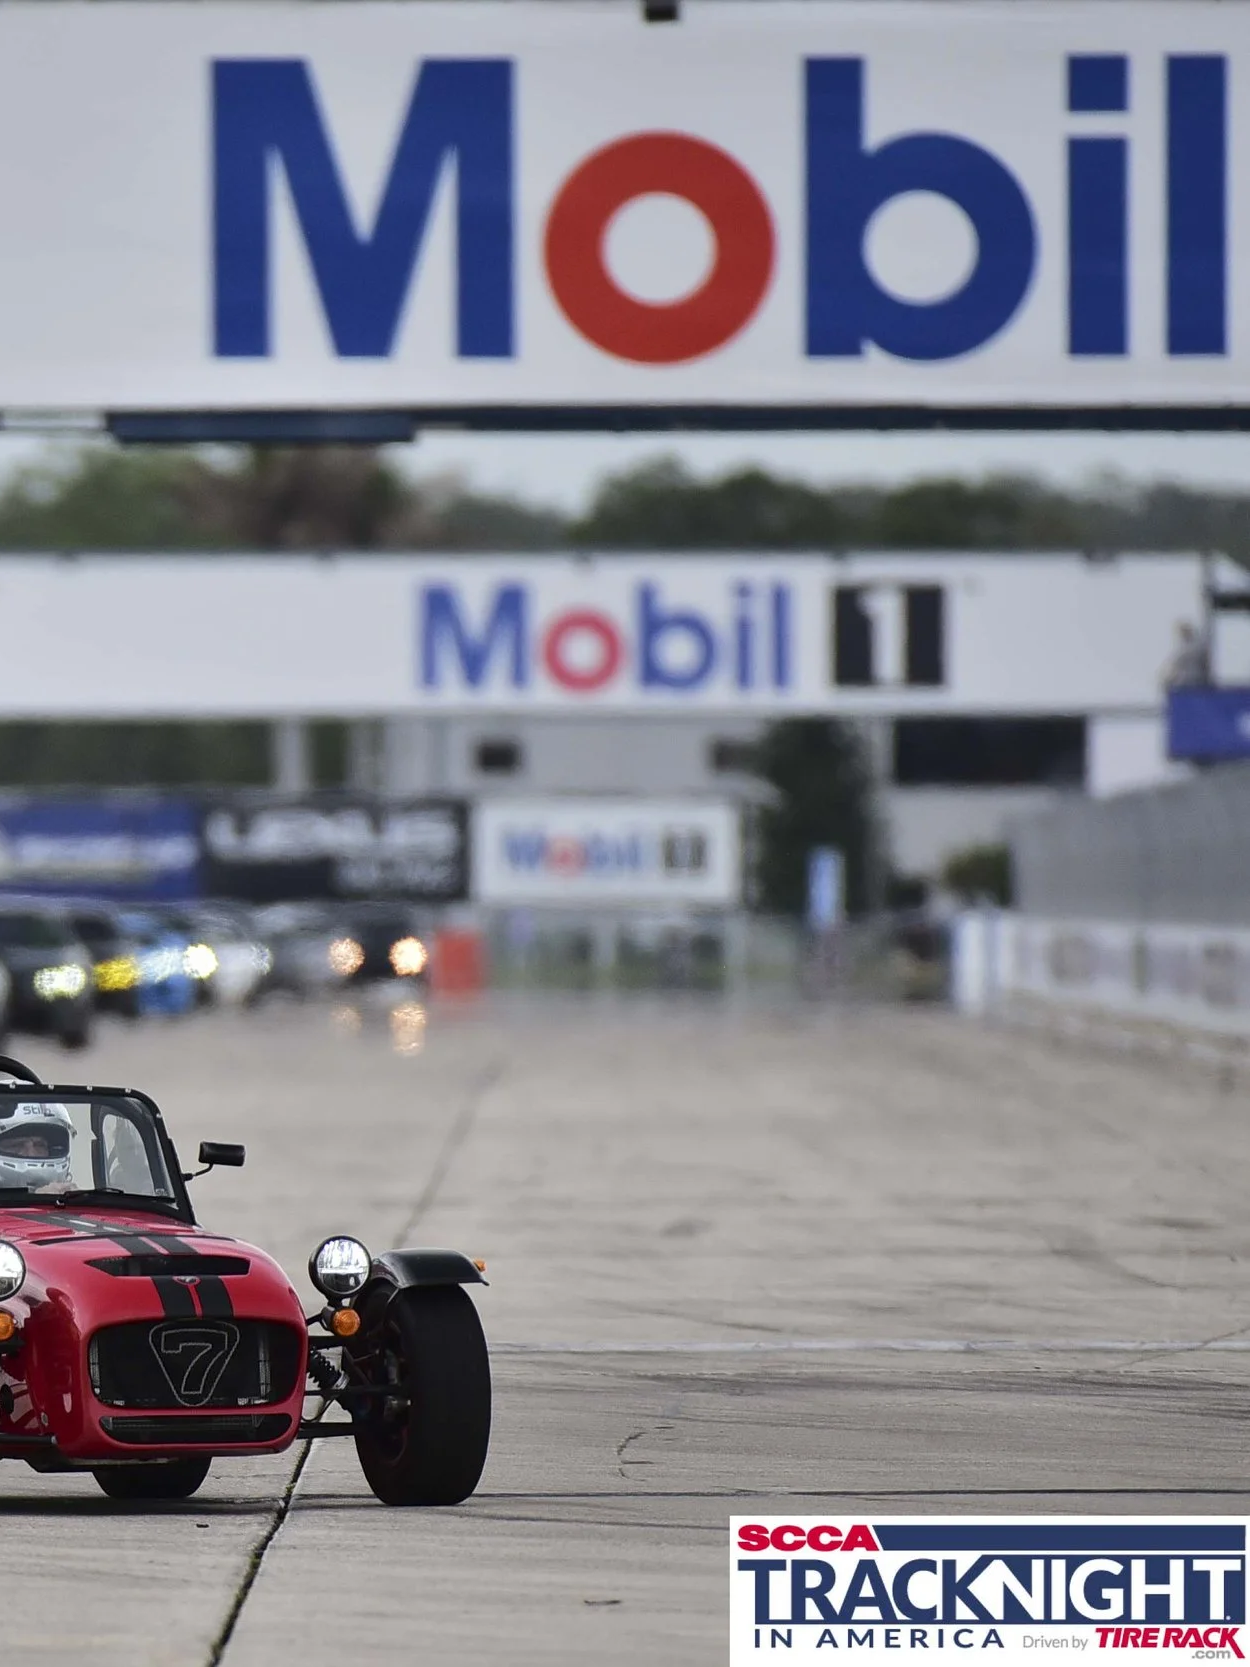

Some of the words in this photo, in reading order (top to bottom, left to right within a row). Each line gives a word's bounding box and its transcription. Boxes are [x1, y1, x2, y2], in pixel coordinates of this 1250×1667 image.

[210, 53, 1228, 366] Mobil
[420, 581, 790, 694] Mobil
[160, 1328, 229, 1395] 7
